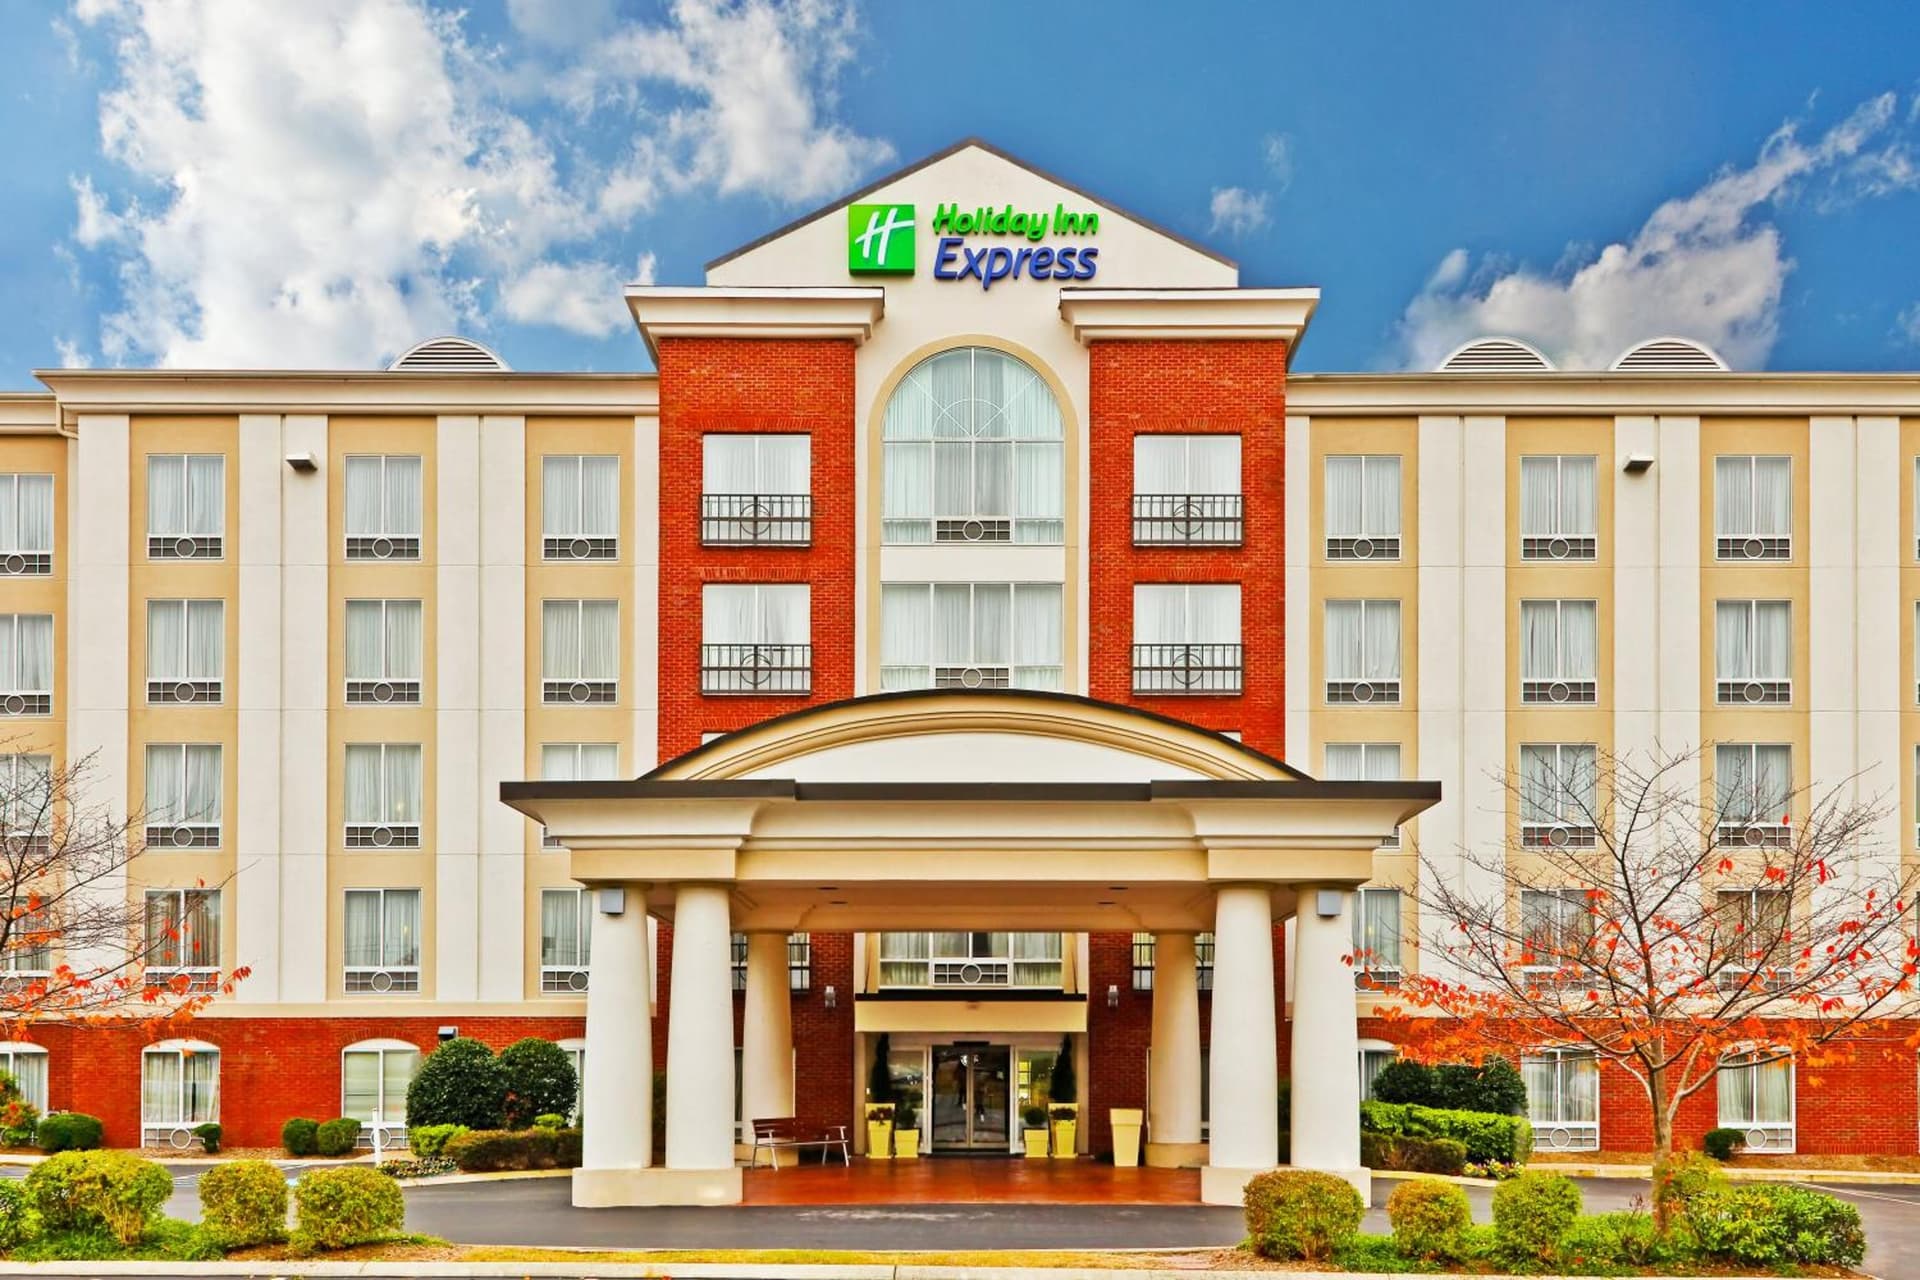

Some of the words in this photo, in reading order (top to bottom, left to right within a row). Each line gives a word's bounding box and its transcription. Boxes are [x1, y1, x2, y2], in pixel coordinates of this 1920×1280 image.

[933, 203, 1049, 241] Holiday
[1053, 203, 1099, 235] Inn
[933, 237, 1099, 291] Express
